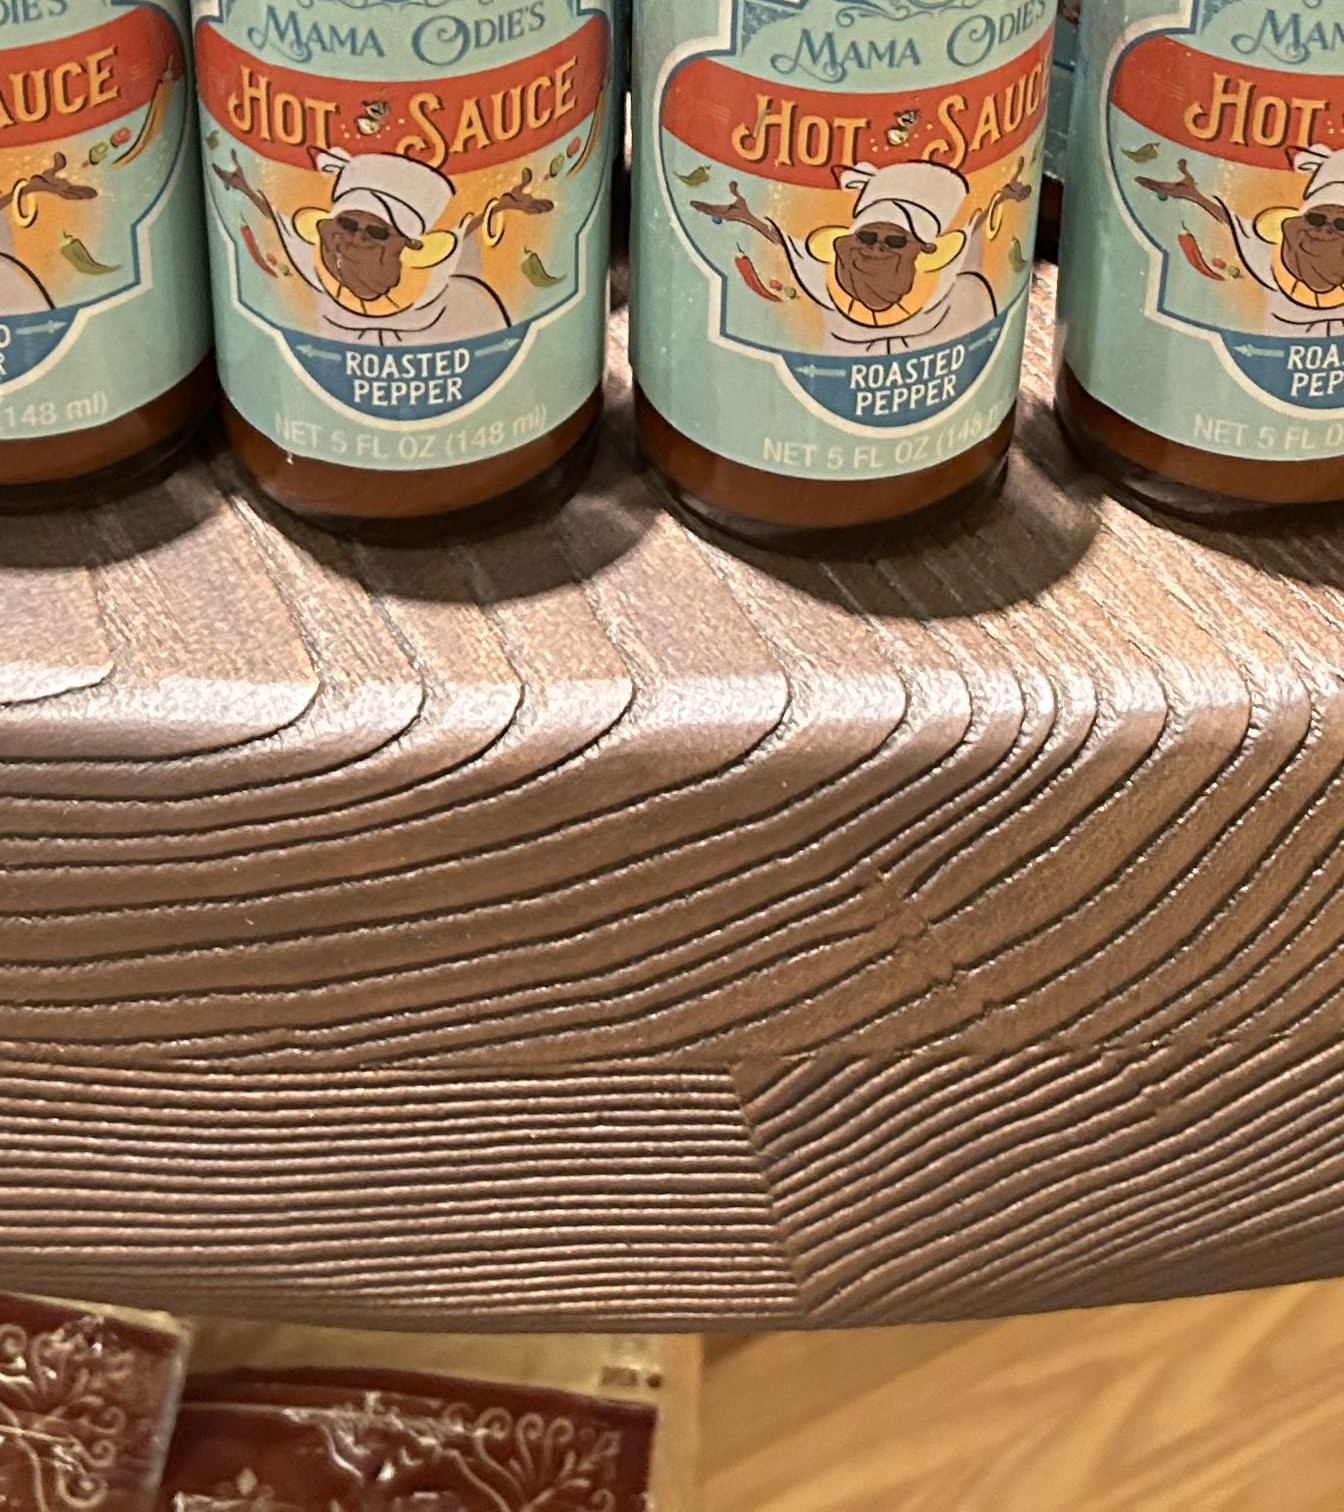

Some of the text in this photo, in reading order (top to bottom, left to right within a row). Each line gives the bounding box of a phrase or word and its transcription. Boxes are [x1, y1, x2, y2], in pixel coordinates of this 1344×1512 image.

[246, 0, 548, 67] MAMA ODIE'S
[770, 27, 922, 84] MAMA
[226, 55, 579, 170] HOT SAUCE
[730, 92, 871, 169] HOT
[1182, 71, 1330, 150] HOT
[345, 347, 471, 379] ROASTED
[849, 344, 966, 390] ROASTED
[353, 377, 464, 407] PEPPER
[855, 374, 958, 418] PEPPER
[274, 410, 322, 449] NET
[331, 431, 349, 455] 5
[356, 434, 391, 461] FL
[397, 435, 437, 460] OZ
[445, 421, 506, 461] (148
[762, 437, 818, 470] NET
[825, 444, 846, 470] 5
[855, 444, 885, 471] FL
[894, 436, 929, 465] OZ
[936, 416, 984, 457] (148
[1192, 413, 1248, 447] NET
[1256, 426, 1276, 451] 5
[1283, 425, 1317, 452] FL
